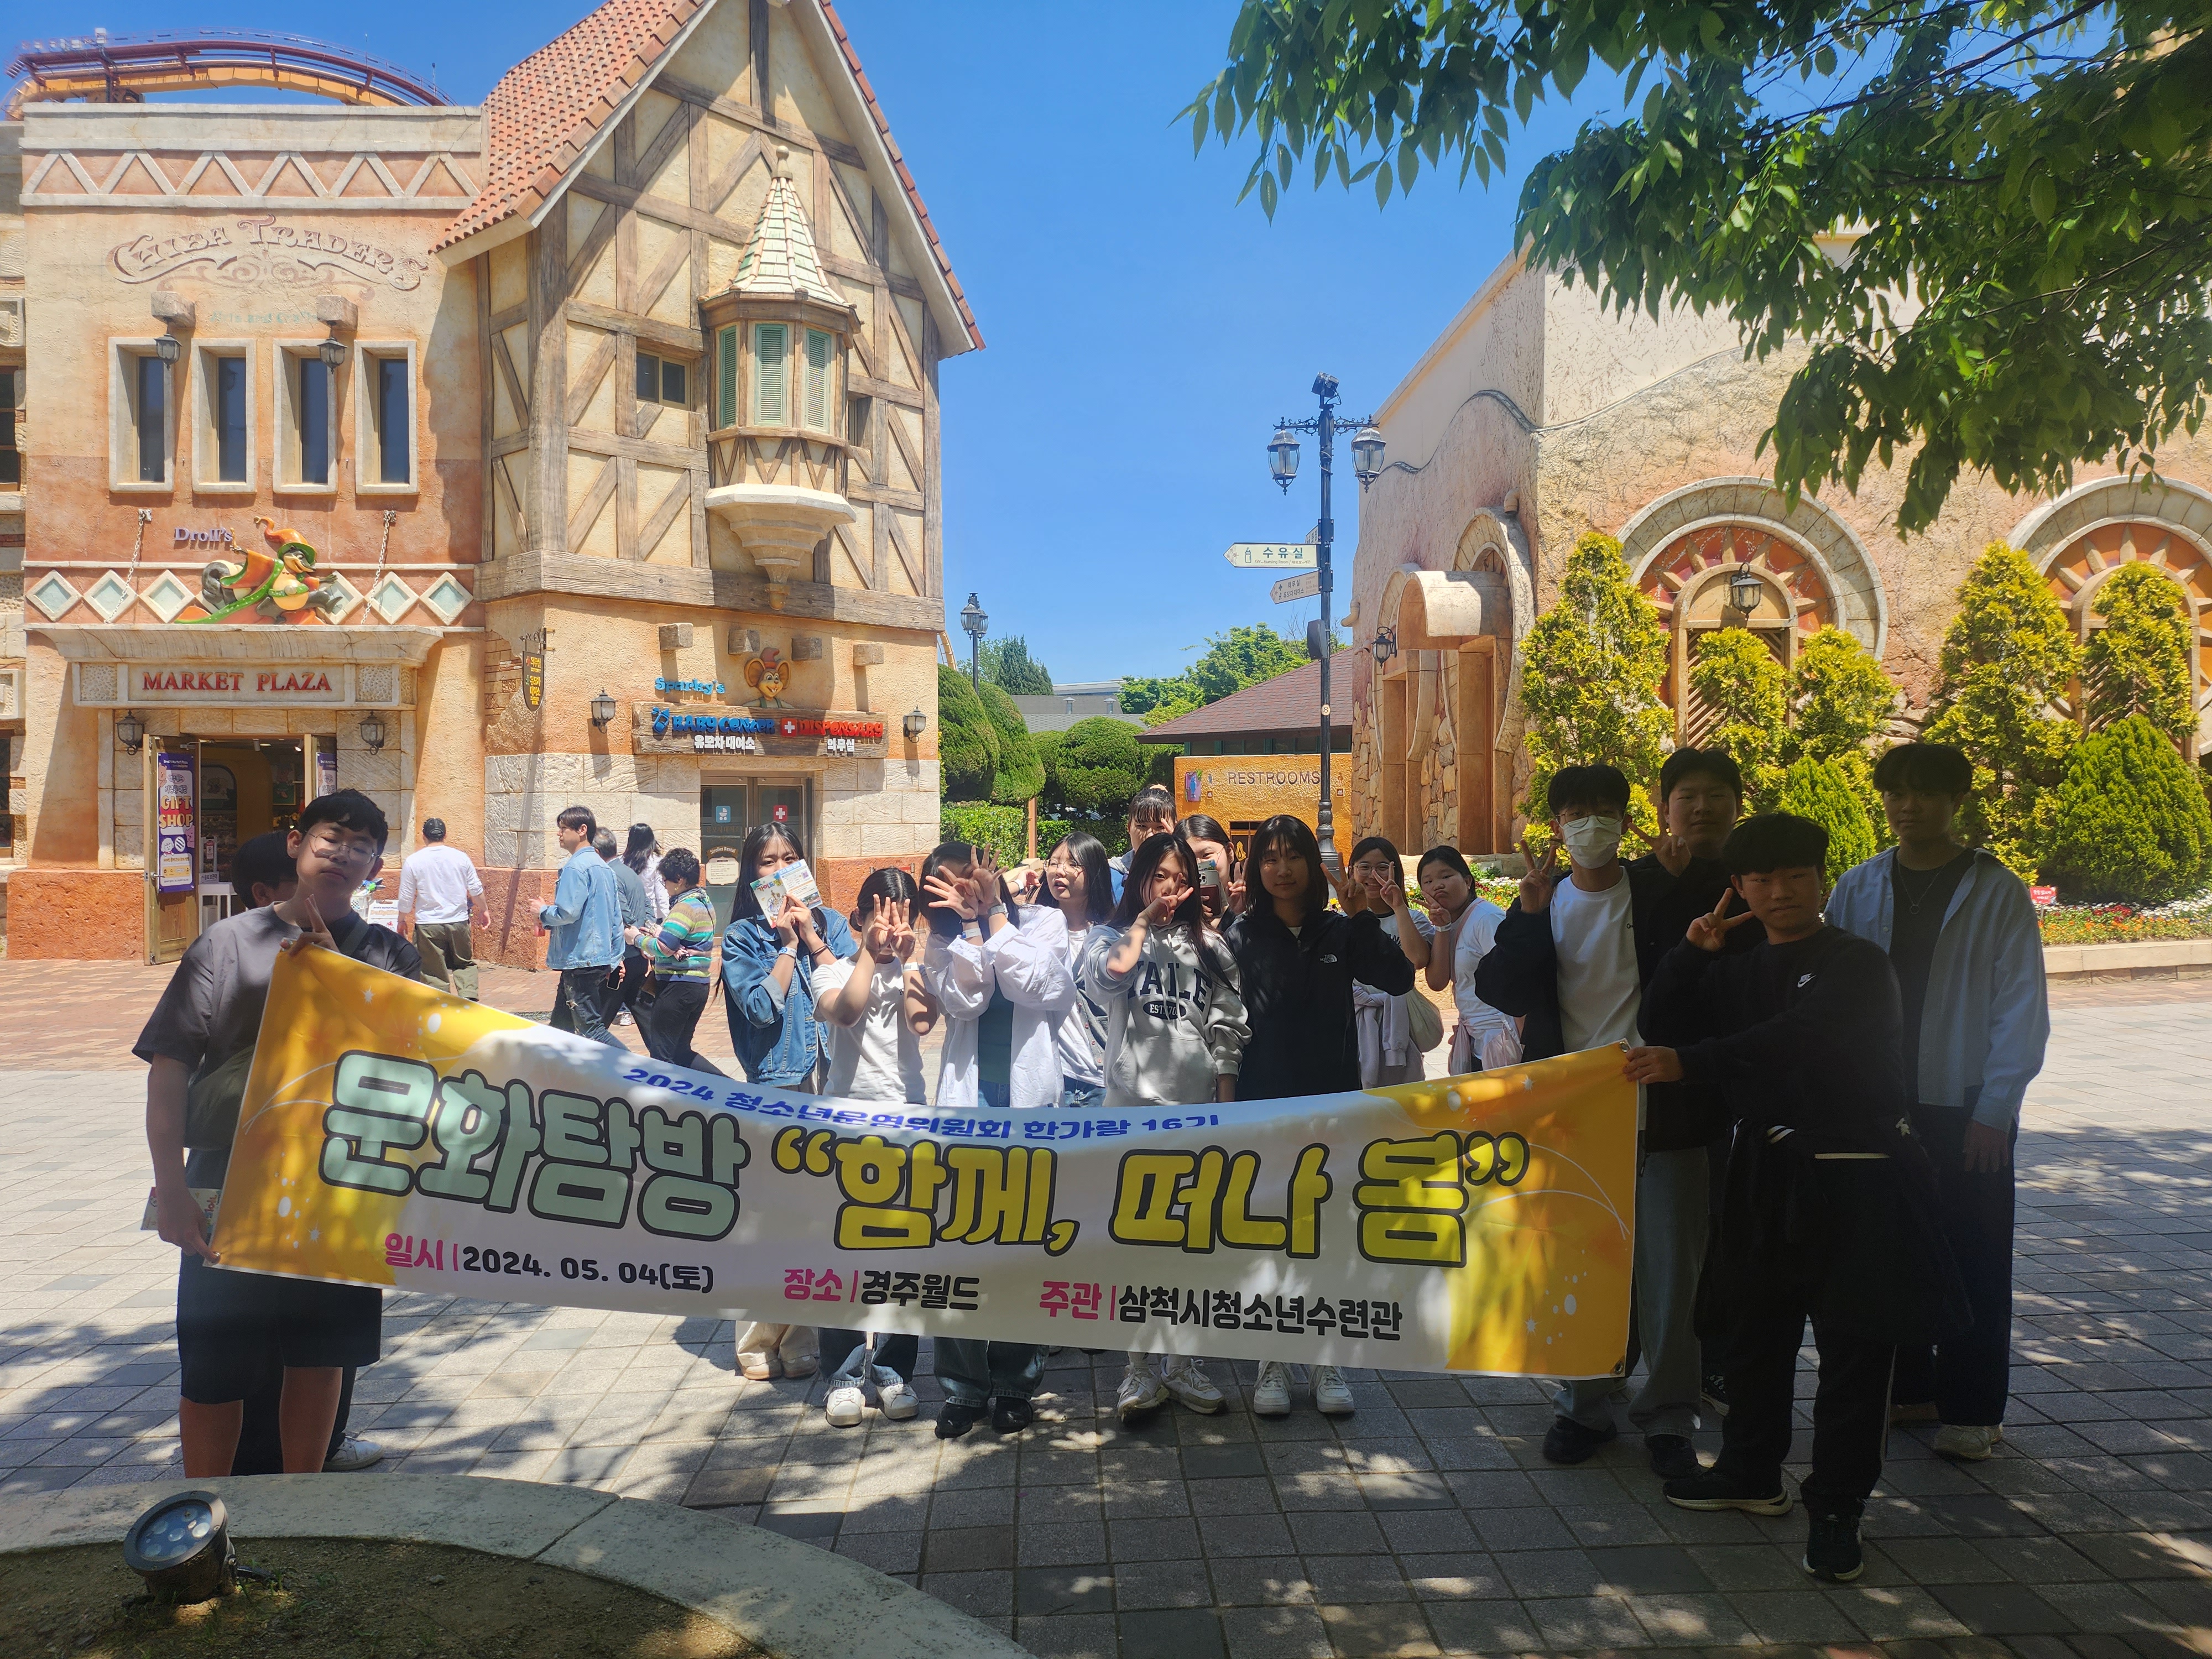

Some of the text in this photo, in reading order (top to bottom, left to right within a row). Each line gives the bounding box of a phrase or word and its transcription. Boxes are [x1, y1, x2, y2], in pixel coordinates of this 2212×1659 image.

[174, 527, 233, 542] Droll's
[1262, 547, 1303, 559] 수유실
[1287, 579, 1300, 589] 의무실
[1283, 587, 1304, 598] 유모차 대여소
[142, 672, 332, 691] MARKET PLAZA
[655, 676, 726, 695] Sparky's
[694, 734, 855, 752] 유모차 대여소 의무실
[1227, 771, 1321, 785] RESTROOMS
[161, 795, 192, 810] GIFT
[159, 813, 194, 828] SHOP
[710, 846, 723, 854] Stroller
[623, 1068, 1219, 1140] 2024 청소년운영위원회 한가람 16기
[317, 1049, 751, 1242] 문화탐방
[1108, 1142, 1333, 1260] 떠나
[384, 1233, 1403, 1341] 일시 2024. 05. 04(토) 장소 경주월드 주관 삼척시청소년수련관
